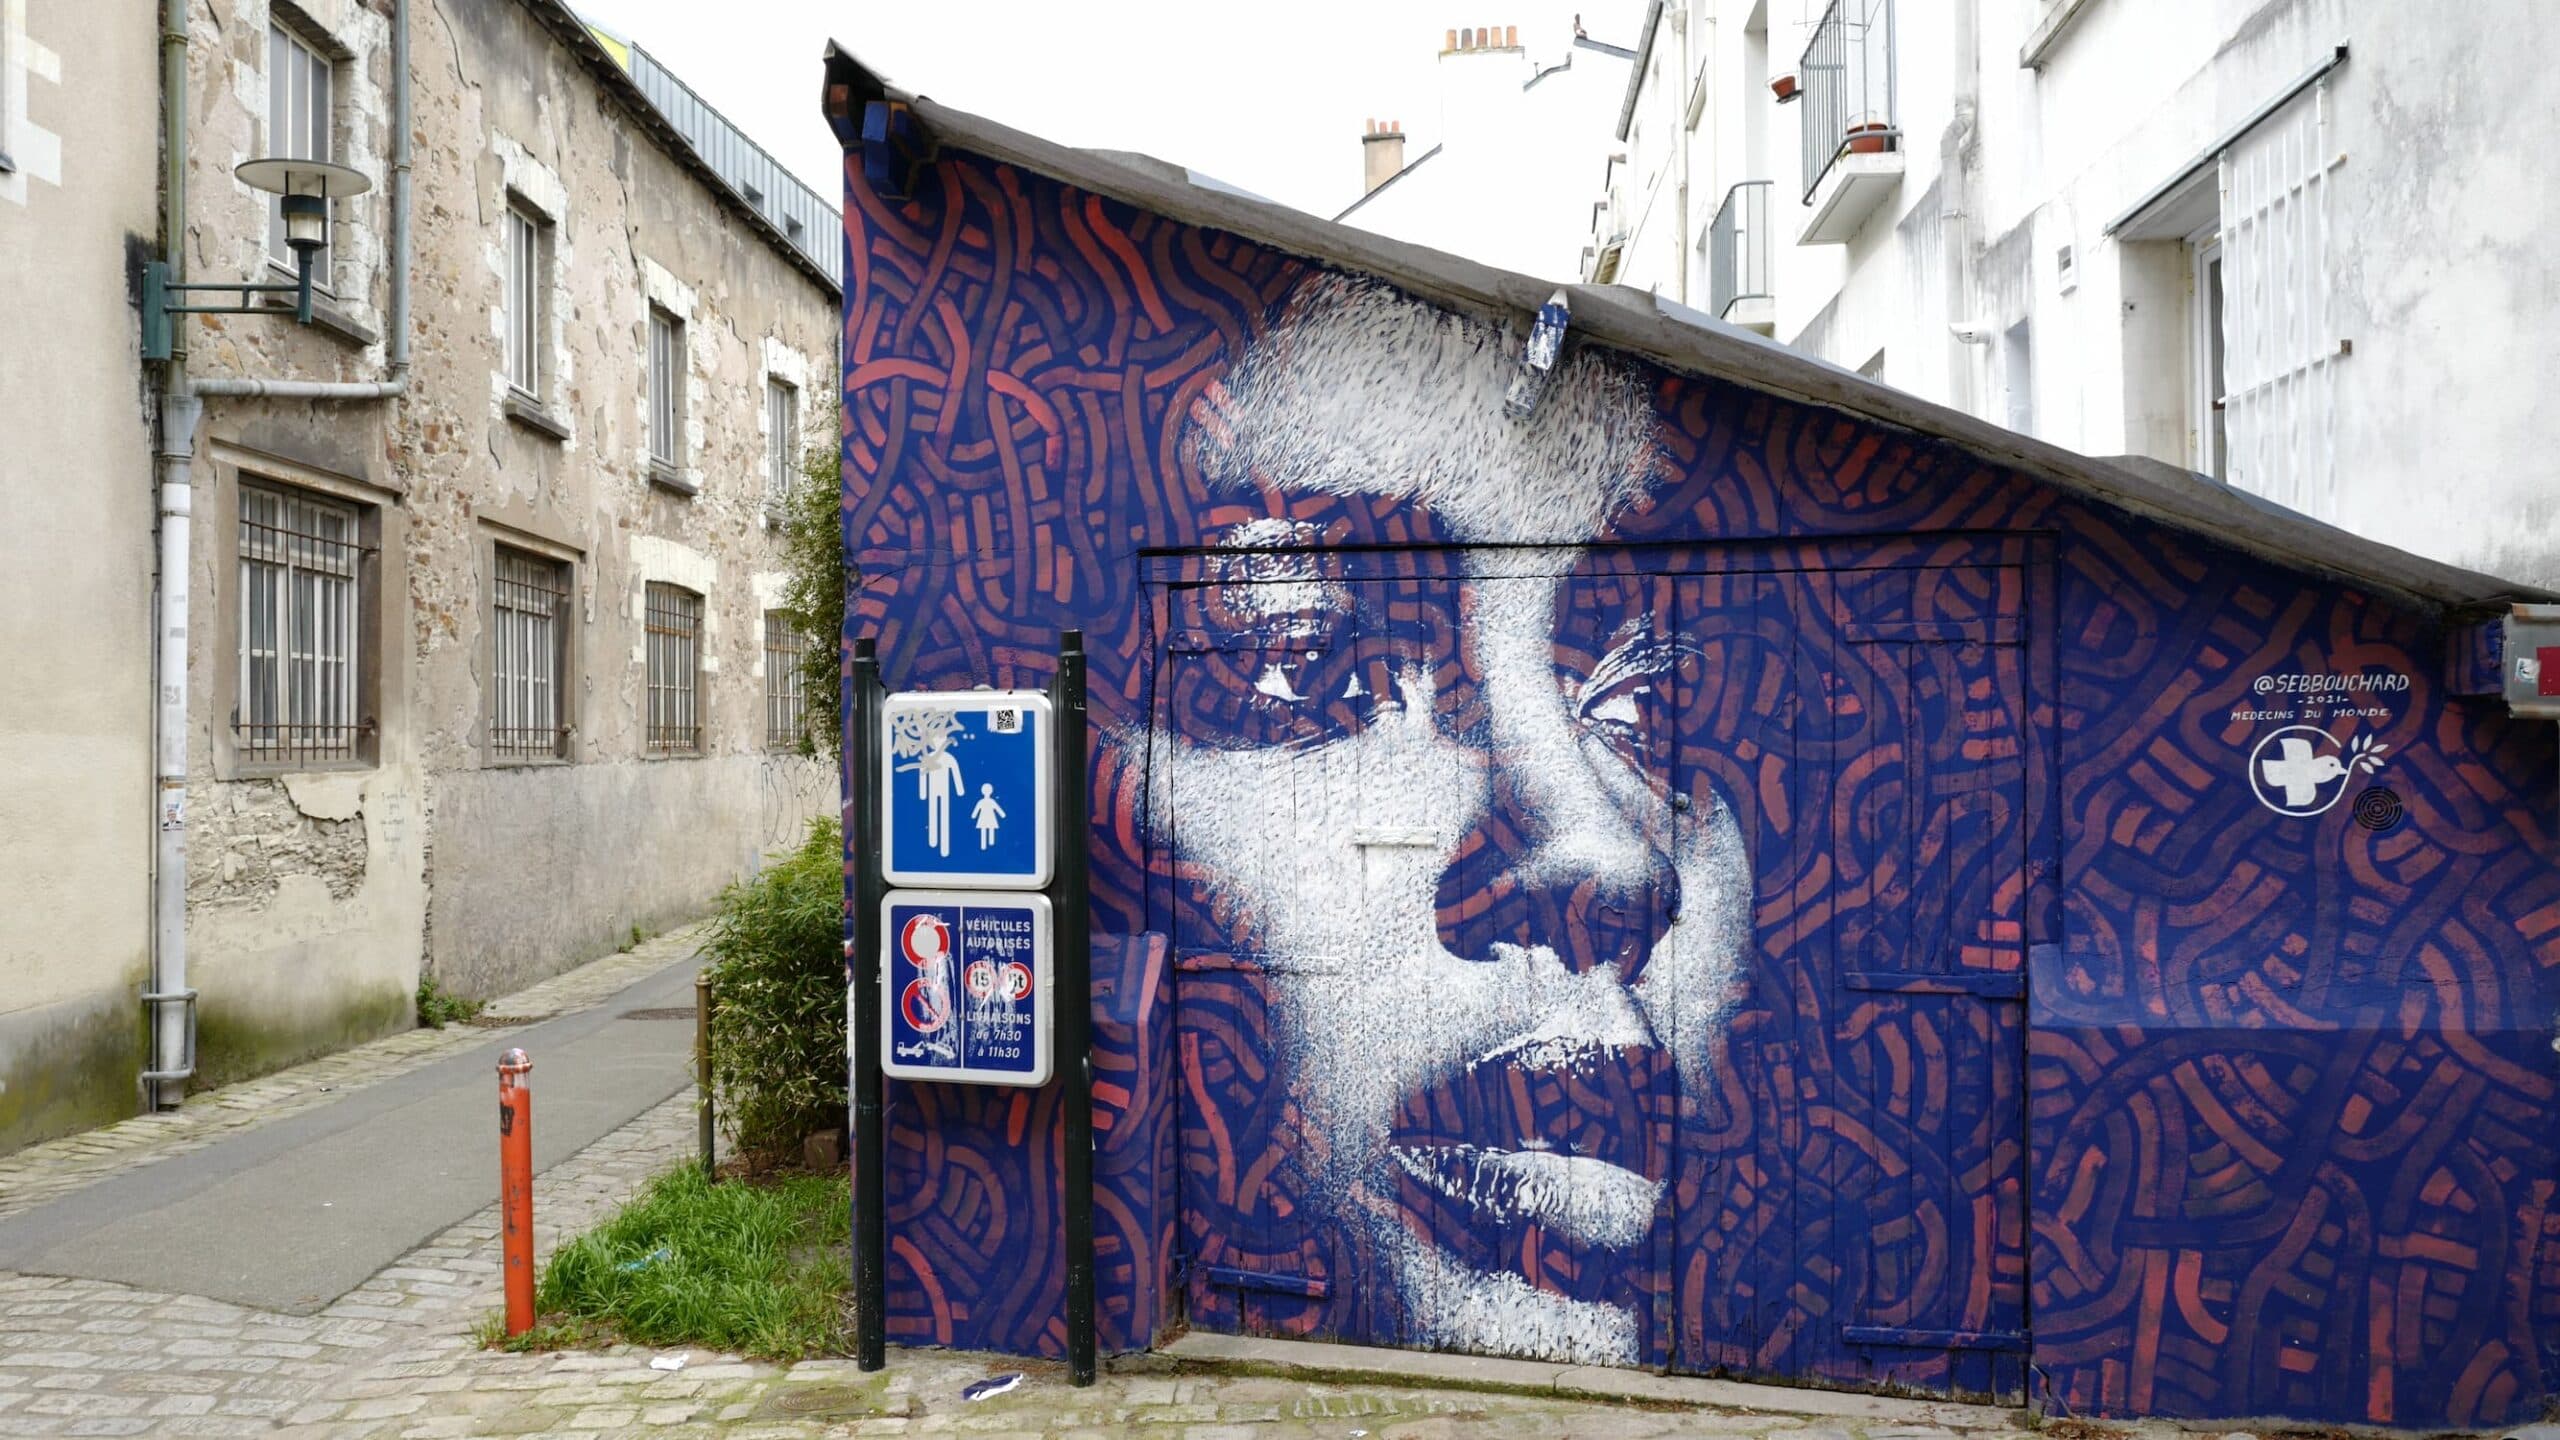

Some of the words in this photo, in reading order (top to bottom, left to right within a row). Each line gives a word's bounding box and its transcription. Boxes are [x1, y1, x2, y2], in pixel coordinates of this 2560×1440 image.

[2254, 674, 2410, 696] @SEBBOUCHARD
[2230, 710, 2294, 720] MEDECINS
[2304, 710, 2321, 719] DU
[2333, 708, 2389, 718] MONDE
[966, 919, 1031, 932] VÉHICULES
[966, 935, 1031, 949] AUTORISÉS
[966, 1011, 1031, 1024] LIVRAISONS
[976, 1030, 989, 1040] de
[994, 1030, 1022, 1041] 7h30
[977, 1045, 984, 1057] à
[988, 1046, 1020, 1058] 11h30
